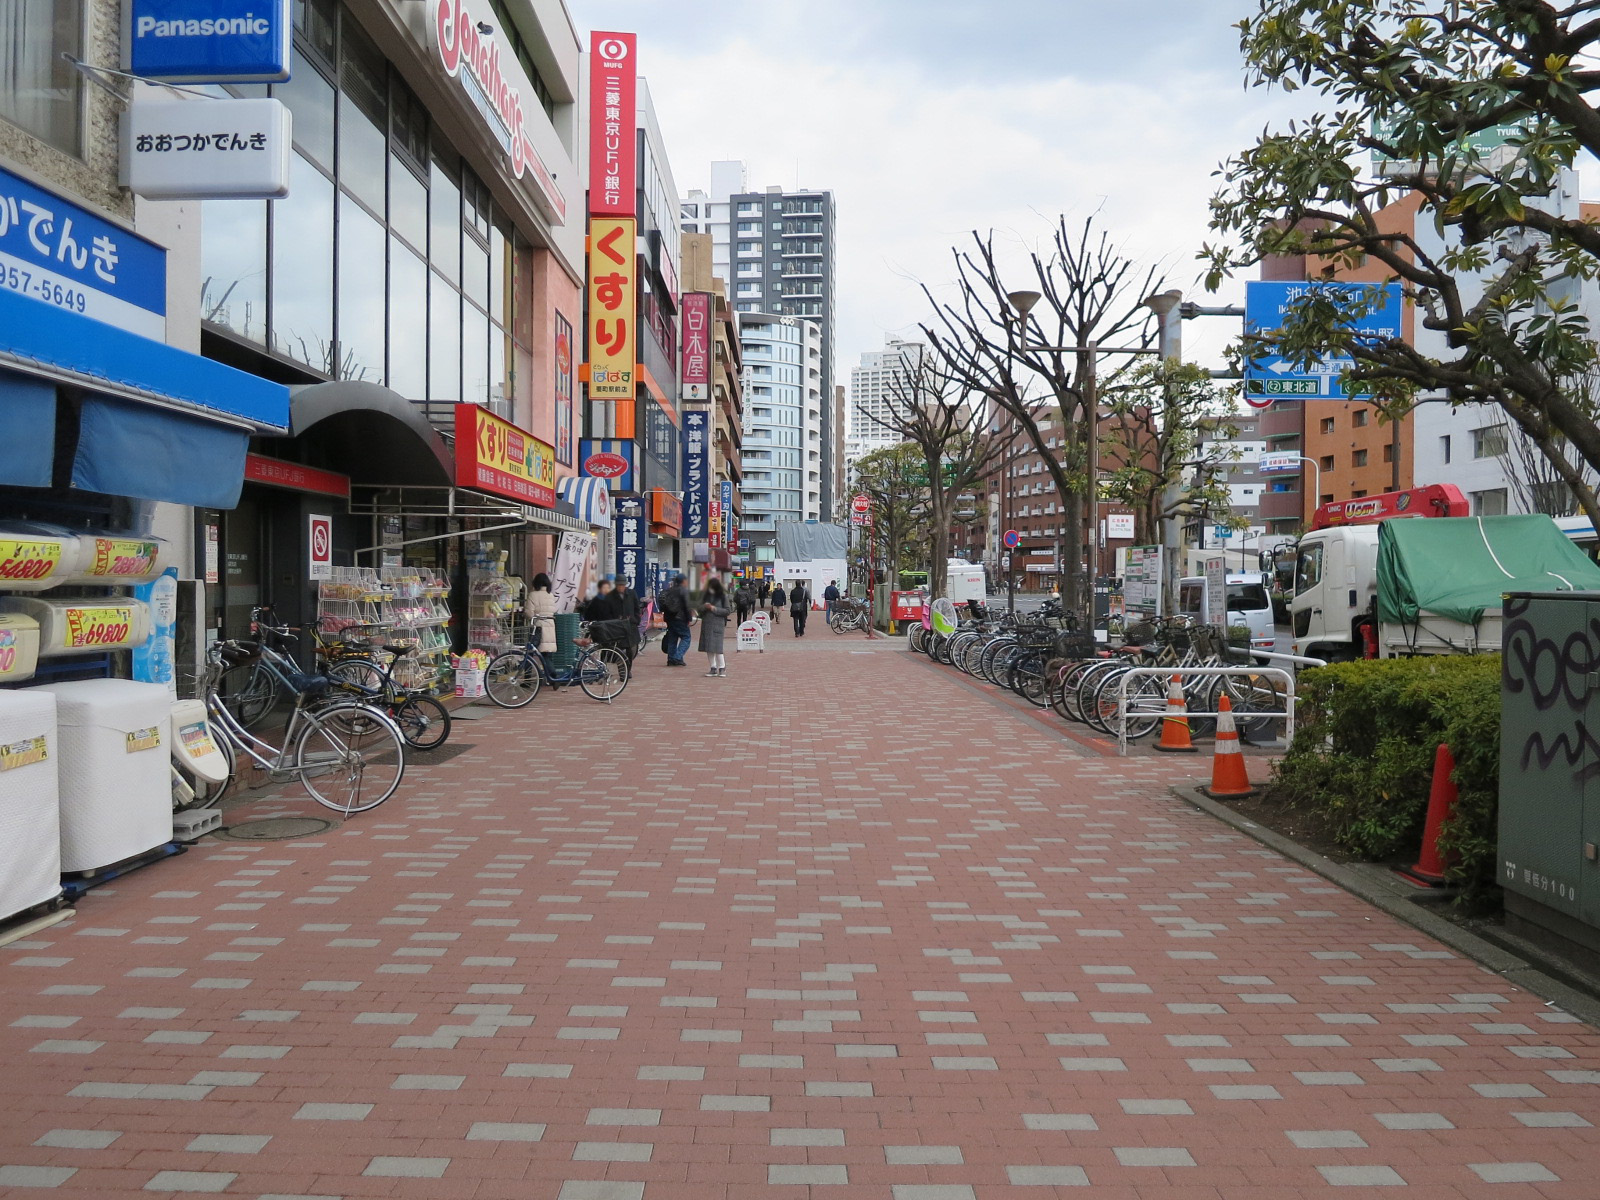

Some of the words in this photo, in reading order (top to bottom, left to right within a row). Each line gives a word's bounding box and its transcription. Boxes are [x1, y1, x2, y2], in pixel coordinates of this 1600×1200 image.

[137, 12, 270, 38] Panasonic
[136, 132, 268, 153] おおつかでんき
[605, 75, 621, 205] 三菱東京UFJ銀行
[593, 226, 629, 357] くすり
[685, 307, 706, 377] 白木屋
[1282, 381, 1317, 393] 東北道
[476, 416, 506, 466] くすり
[687, 414, 703, 537] 本・洋服・ブランドバッグ
[1327, 504, 1342, 513] UNIC
